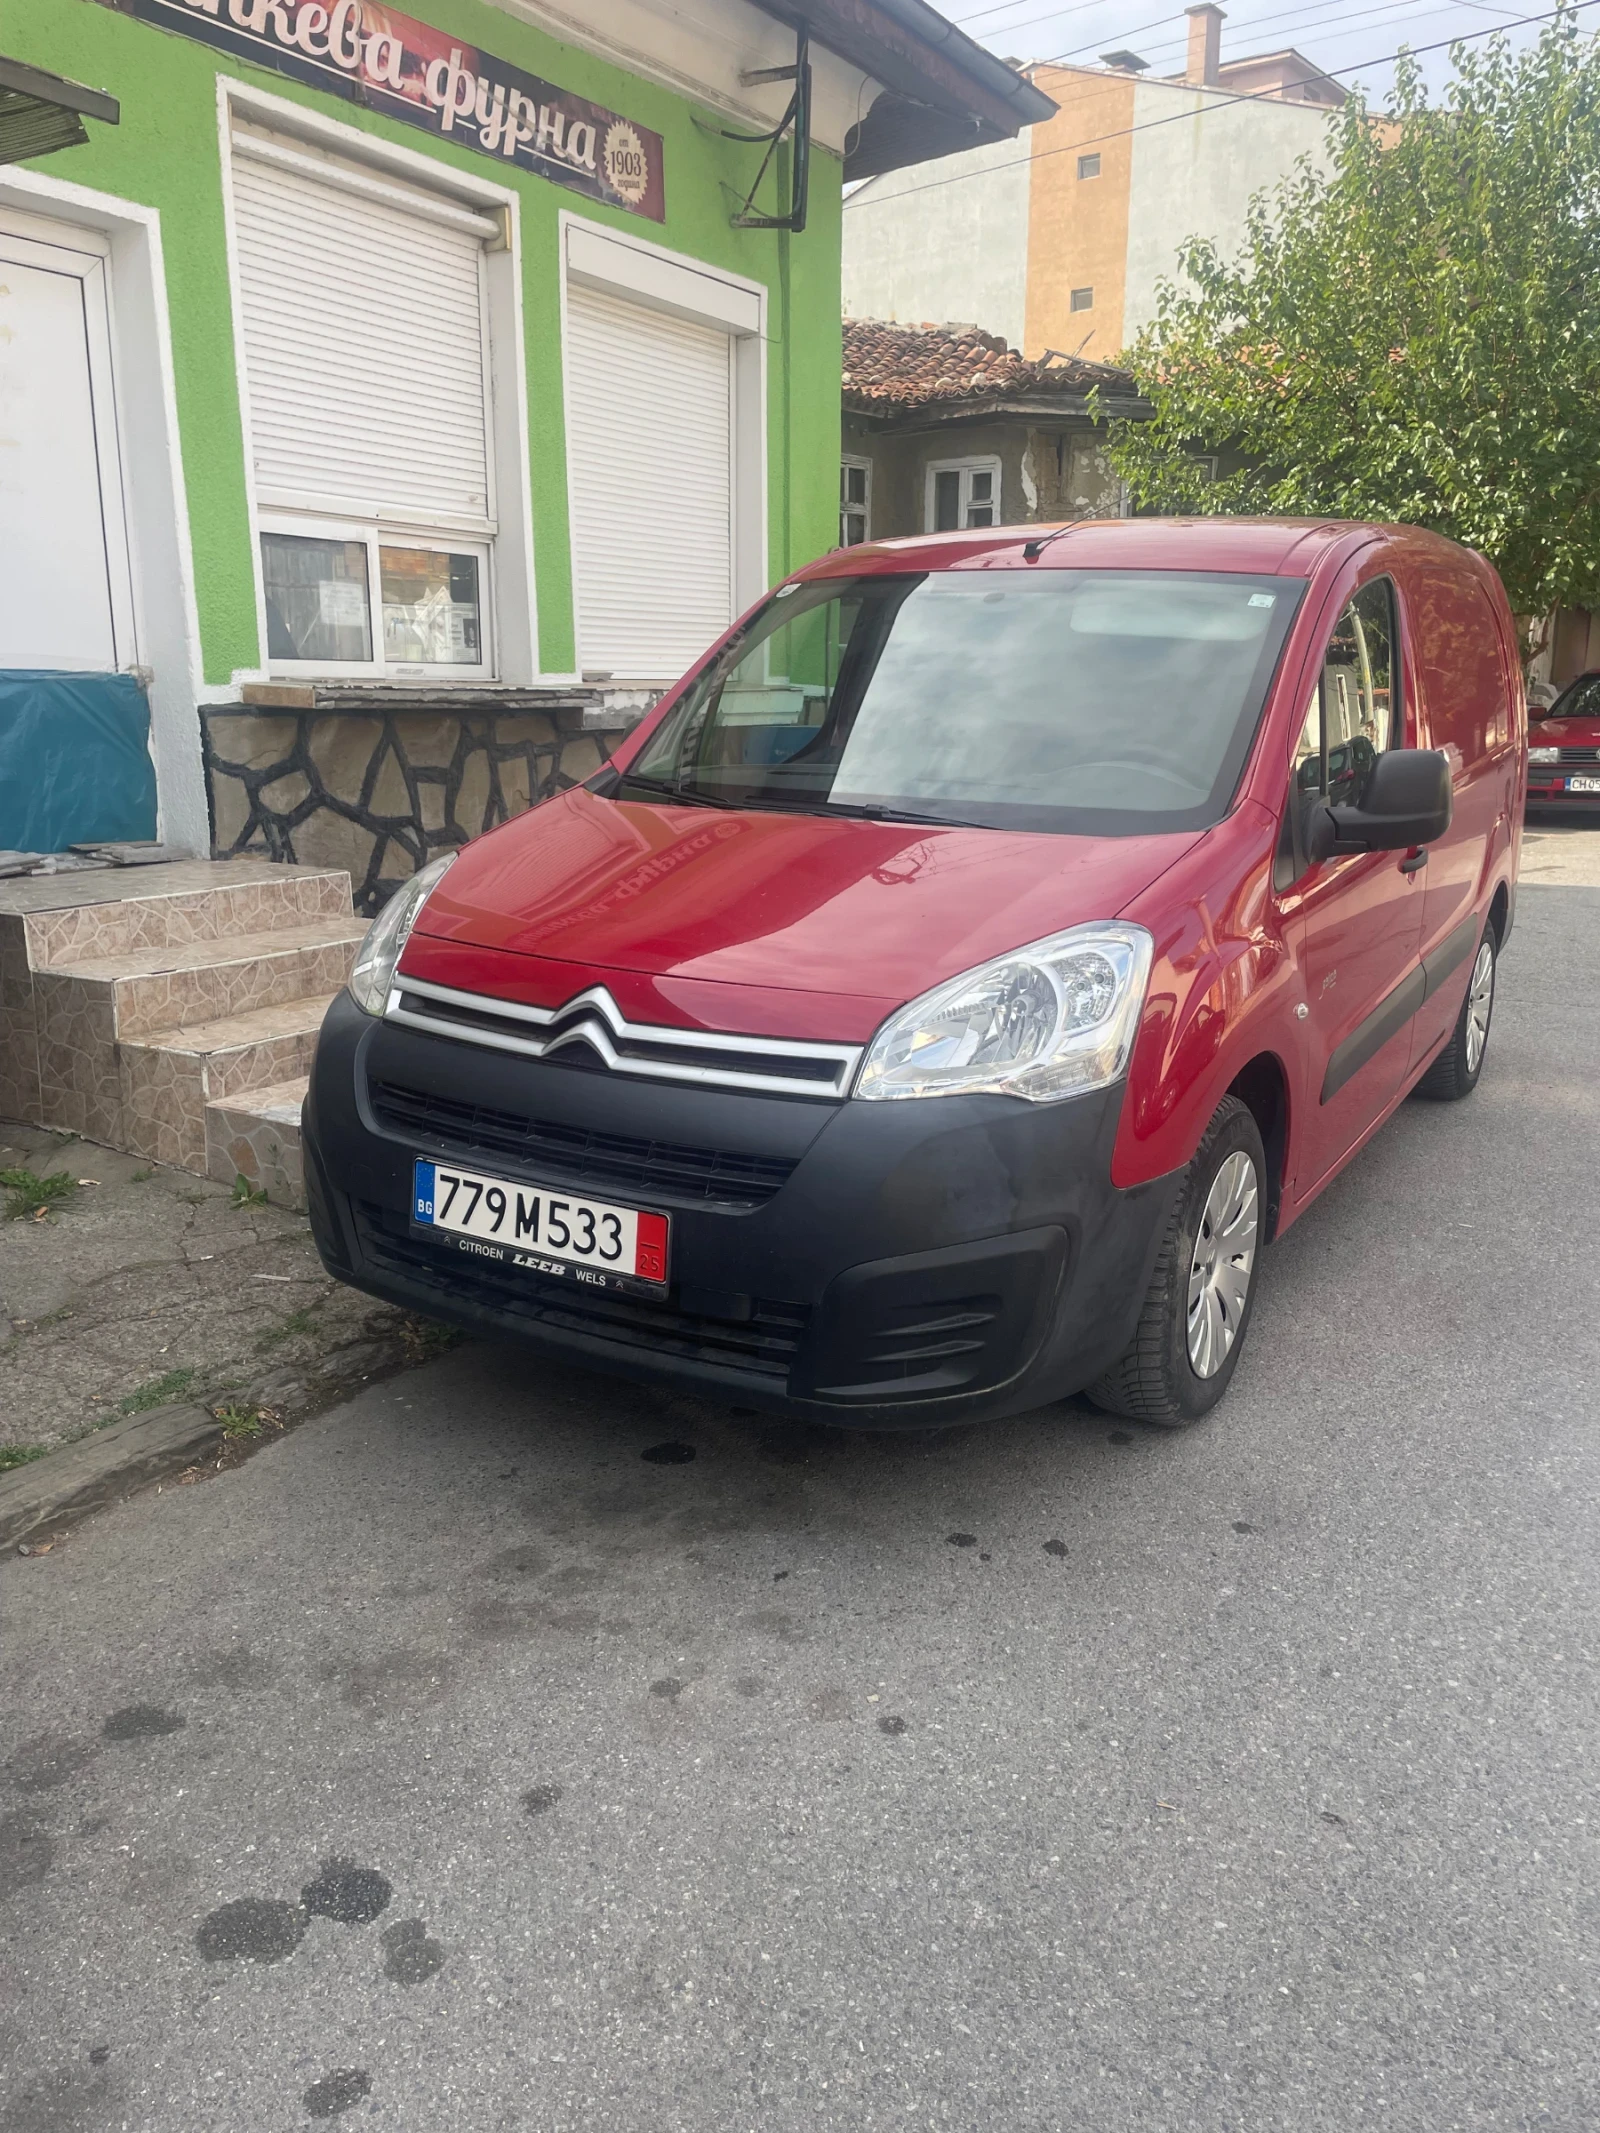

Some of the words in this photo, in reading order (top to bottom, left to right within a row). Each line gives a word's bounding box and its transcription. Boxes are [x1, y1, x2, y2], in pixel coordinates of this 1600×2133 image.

[183, 0, 404, 89] кева
[425, 48, 597, 170] фурна
[610, 150, 642, 177] 1903
[417, 1198, 433, 1215] BG
[459, 1239, 504, 1260] CITROEN
[512, 1253, 566, 1276] LEEB
[575, 1268, 606, 1287] WELS
[640, 1253, 660, 1272] 25
